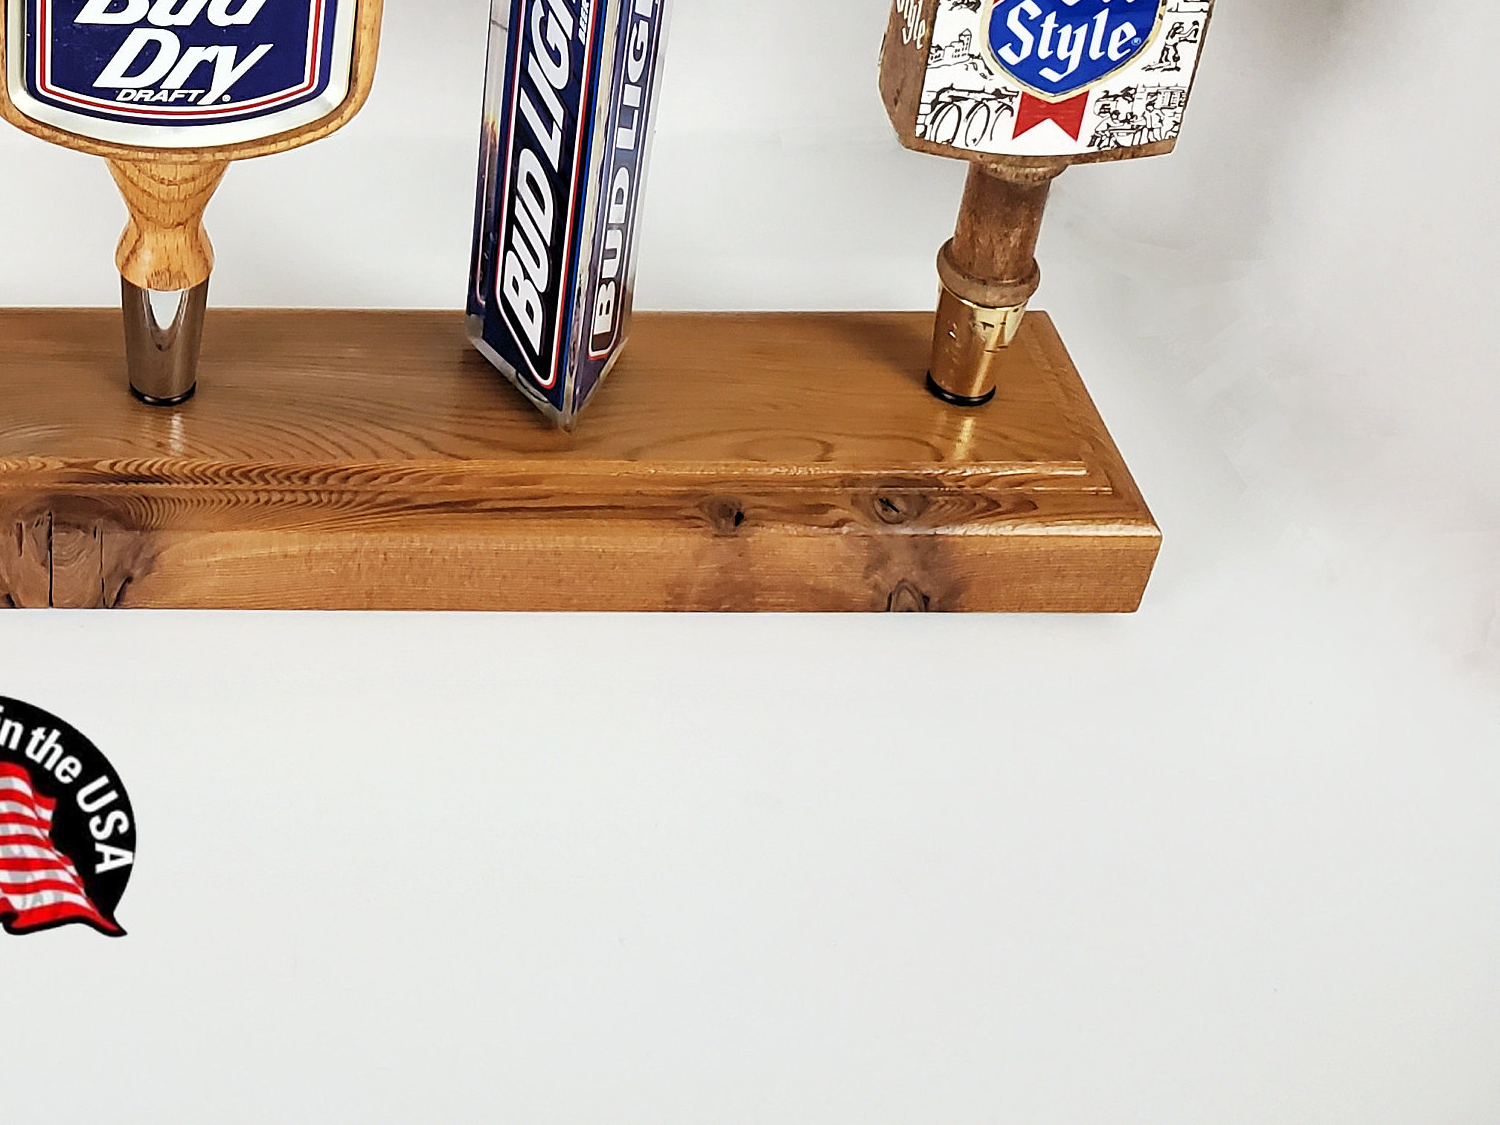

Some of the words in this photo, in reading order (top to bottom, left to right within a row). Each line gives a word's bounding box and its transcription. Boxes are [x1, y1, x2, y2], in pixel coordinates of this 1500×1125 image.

[91, 27, 274, 105] Dry
[115, 88, 206, 103] DRAFT
[503, 148, 554, 356] BUD
[592, 166, 630, 335] BUD
